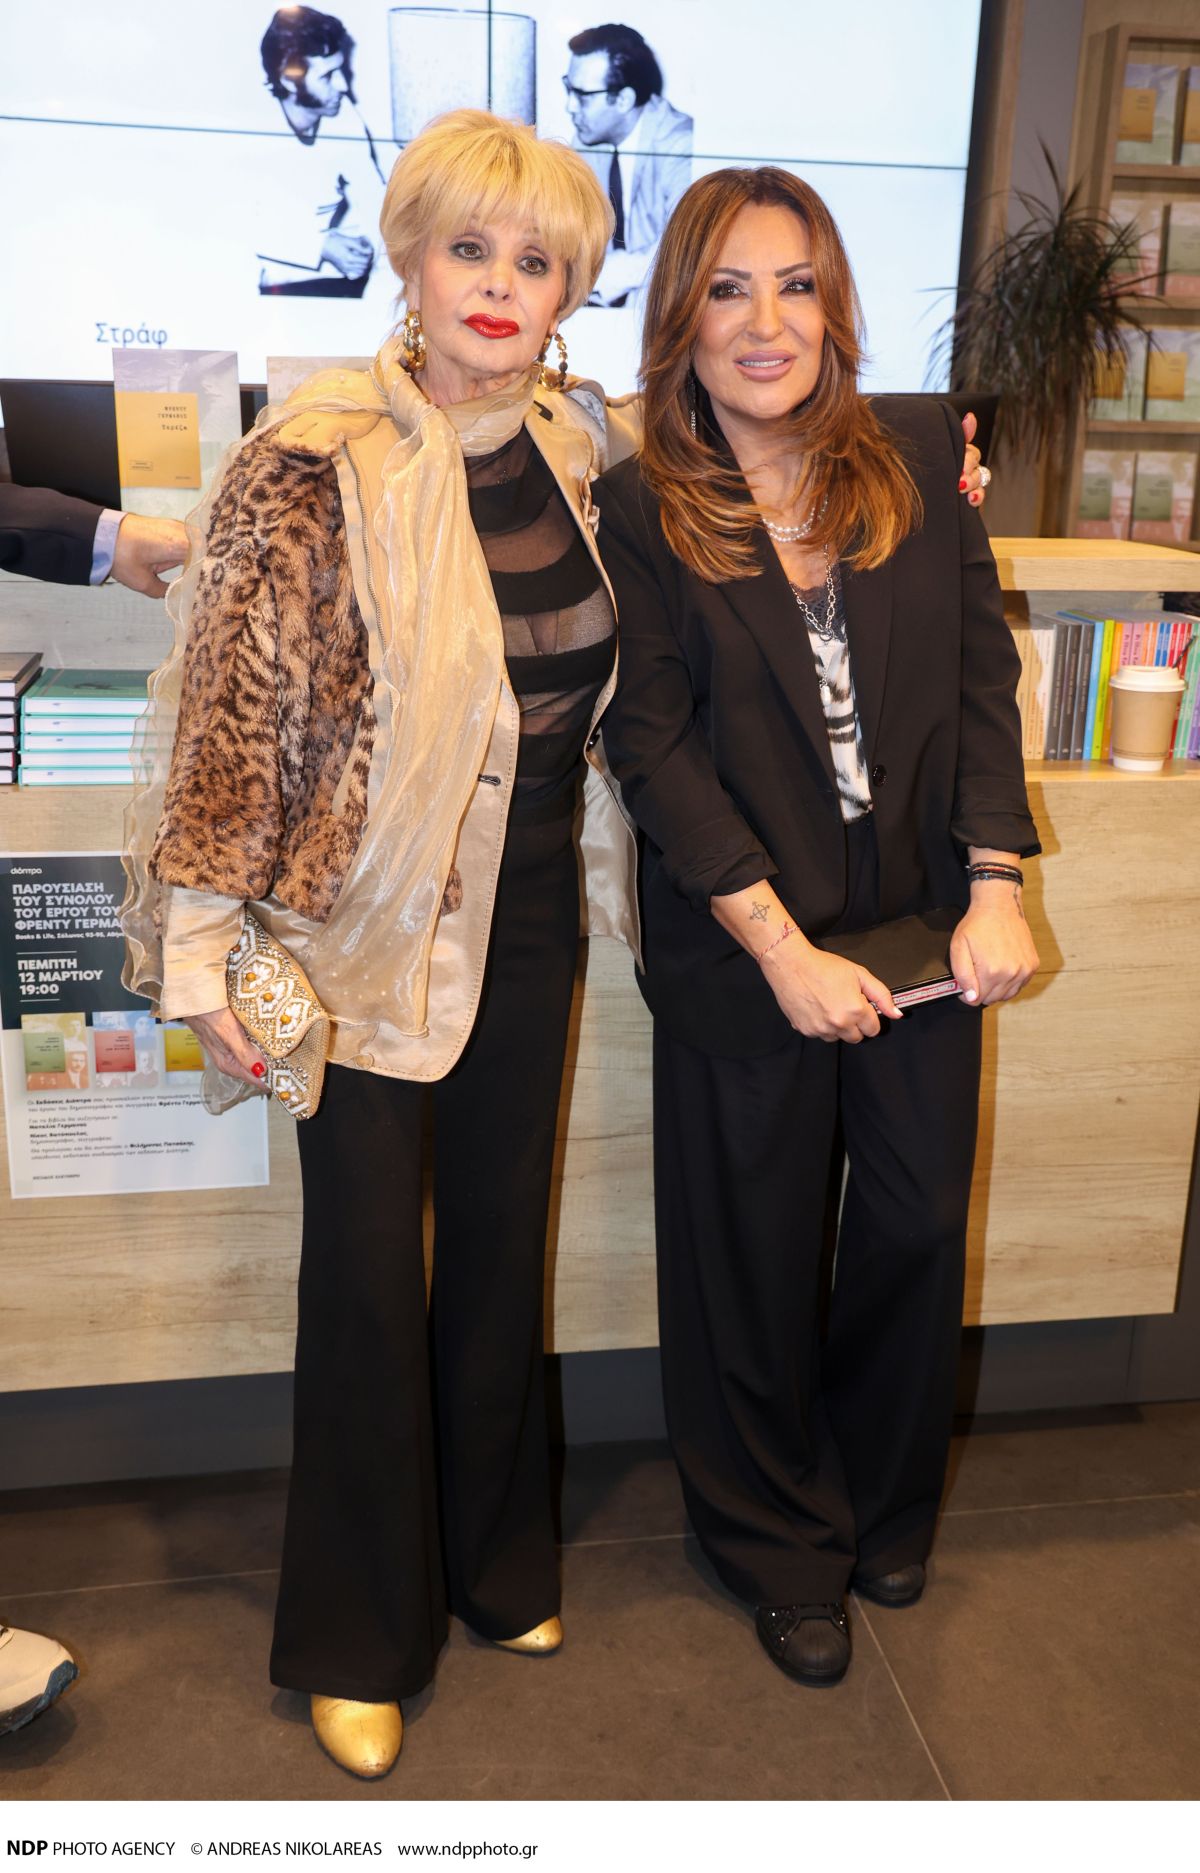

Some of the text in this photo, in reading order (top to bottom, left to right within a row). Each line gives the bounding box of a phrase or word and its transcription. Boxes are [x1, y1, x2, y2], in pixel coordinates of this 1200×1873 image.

[95, 322, 168, 349] Στράφ
[12, 882, 105, 895] ΠΑΡΟΥΣΙΑΣΗ
[13, 893, 115, 907] ΤΟΥ ΣΥΝΟΛΟΥ
[14, 905, 121, 919] ΤΟΥ ΕΡΓΟΥ ΤΟΥ
[14, 917, 145, 931] ΦΡΕΝΤΥ ΓΕΡΜΑ
[17, 958, 78, 971] ΠΕΜΠΤΗ
[18, 969, 104, 983] 12 ΜΑΡΤΙΟΥ
[19, 983, 60, 996] 19:00
